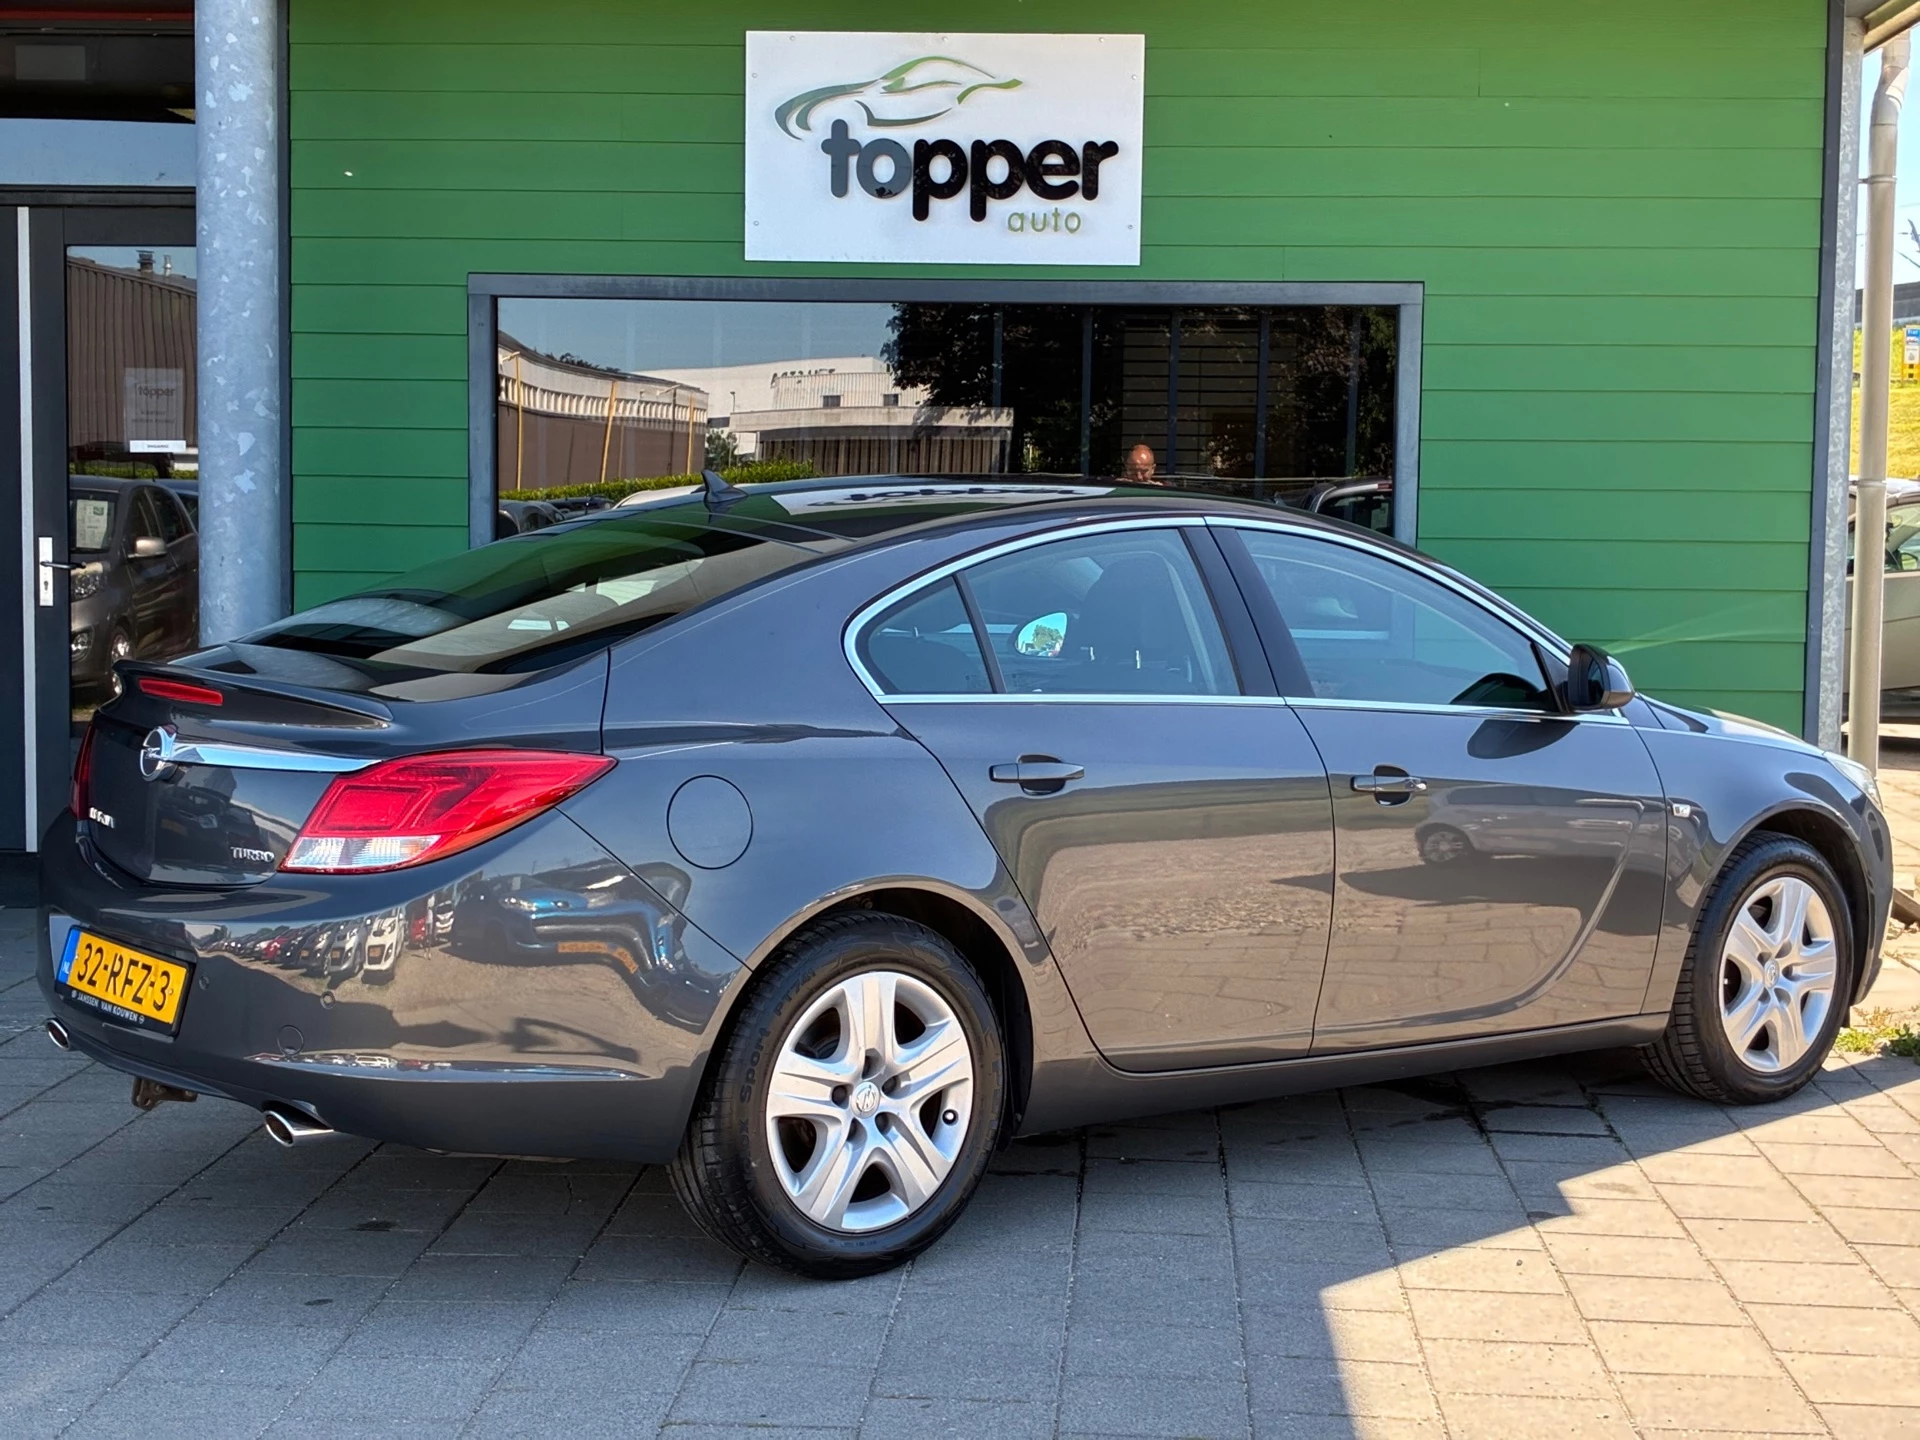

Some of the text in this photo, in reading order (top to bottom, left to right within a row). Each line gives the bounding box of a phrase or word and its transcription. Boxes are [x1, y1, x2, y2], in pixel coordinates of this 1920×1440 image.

[821, 118, 1119, 222] topper
[1007, 208, 1082, 234] auto
[230, 846, 275, 862] TURBO
[77, 943, 171, 1012] 32-RFZ-3
[77, 991, 138, 1022] JANSSEN VAN KOUWEN
